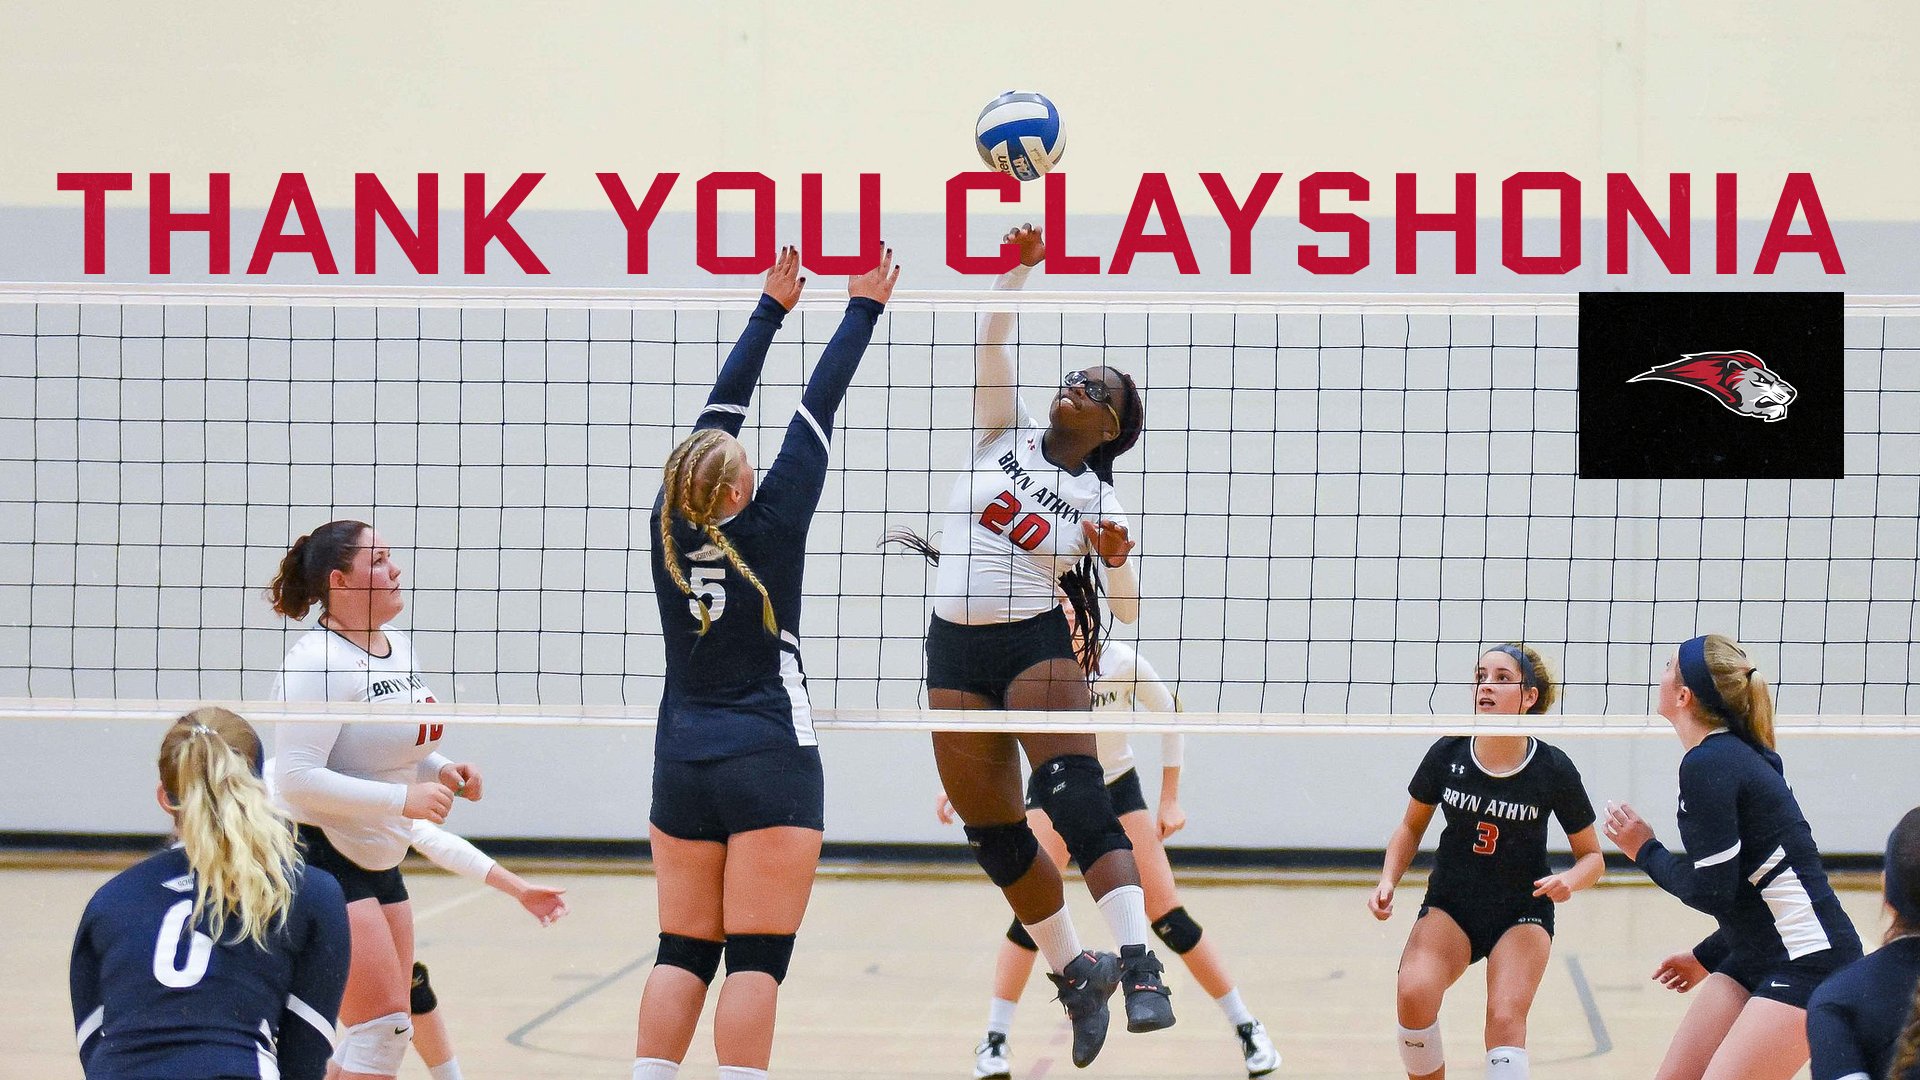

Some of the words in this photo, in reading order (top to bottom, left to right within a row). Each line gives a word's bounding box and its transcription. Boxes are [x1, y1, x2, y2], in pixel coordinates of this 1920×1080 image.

[998, 450, 1035, 491] BRYN
[1031, 487, 1082, 525] ATHYN
[979, 490, 1051, 550] 20
[688, 567, 726, 622] 5
[372, 679, 409, 697] BRYN
[1442, 787, 1482, 813] BRYN
[1484, 799, 1539, 821] ATHYN
[1472, 820, 1500, 856] 3
[153, 899, 215, 988] 0
